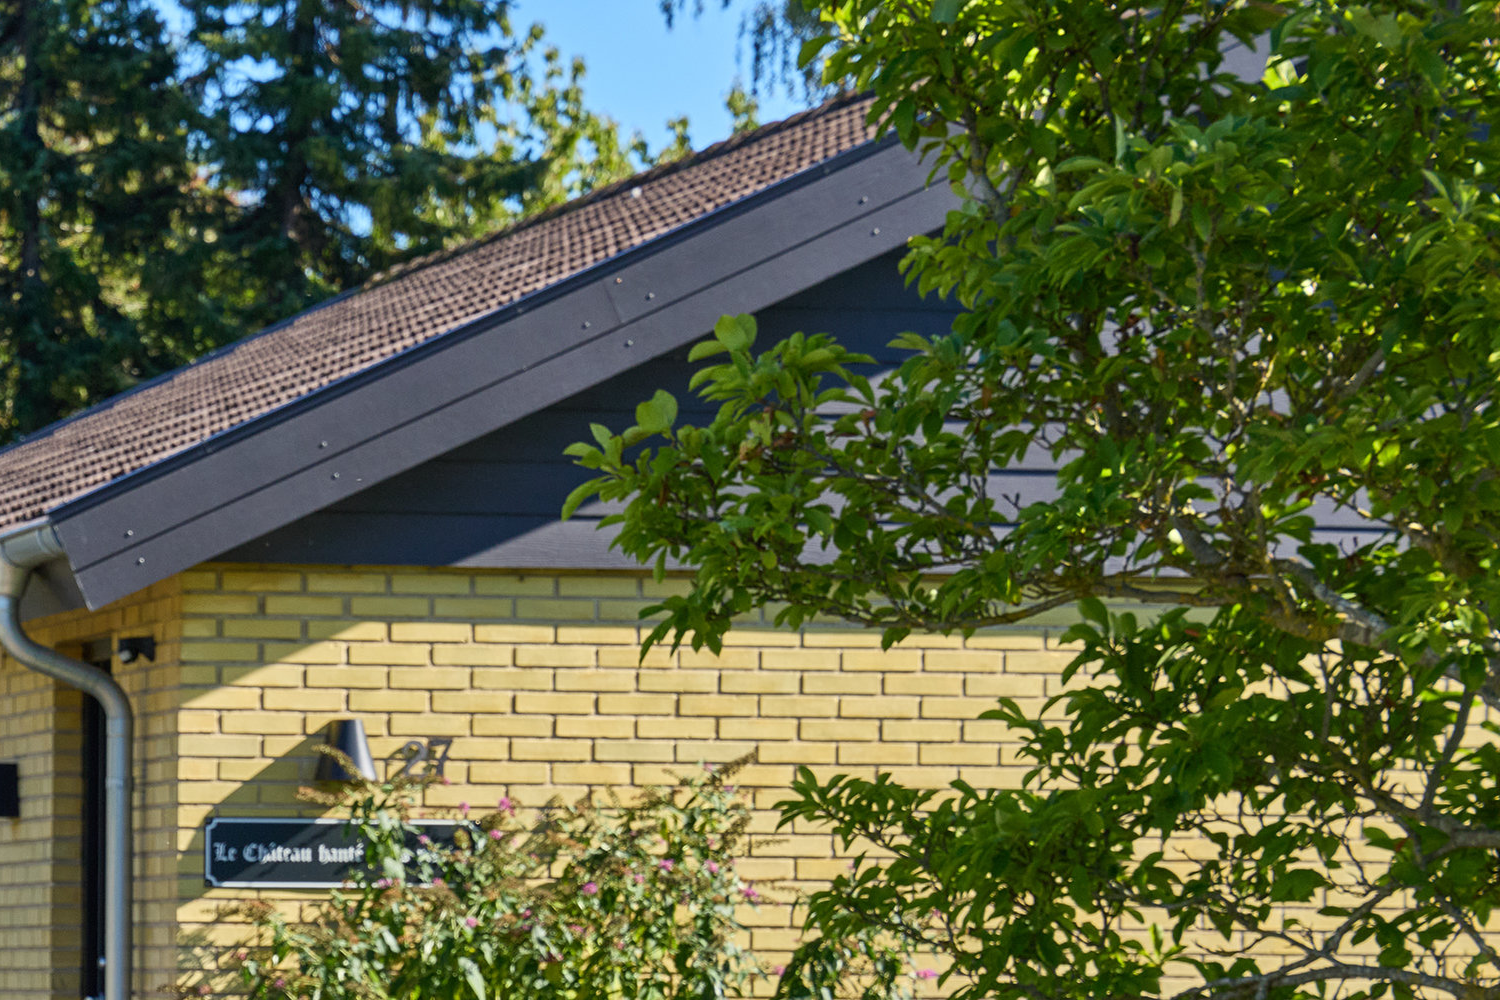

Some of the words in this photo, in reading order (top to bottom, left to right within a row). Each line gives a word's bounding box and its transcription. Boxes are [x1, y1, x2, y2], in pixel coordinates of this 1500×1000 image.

[402, 737, 453, 778] 27
[213, 842, 237, 862] Le
[242, 841, 313, 864] Château
